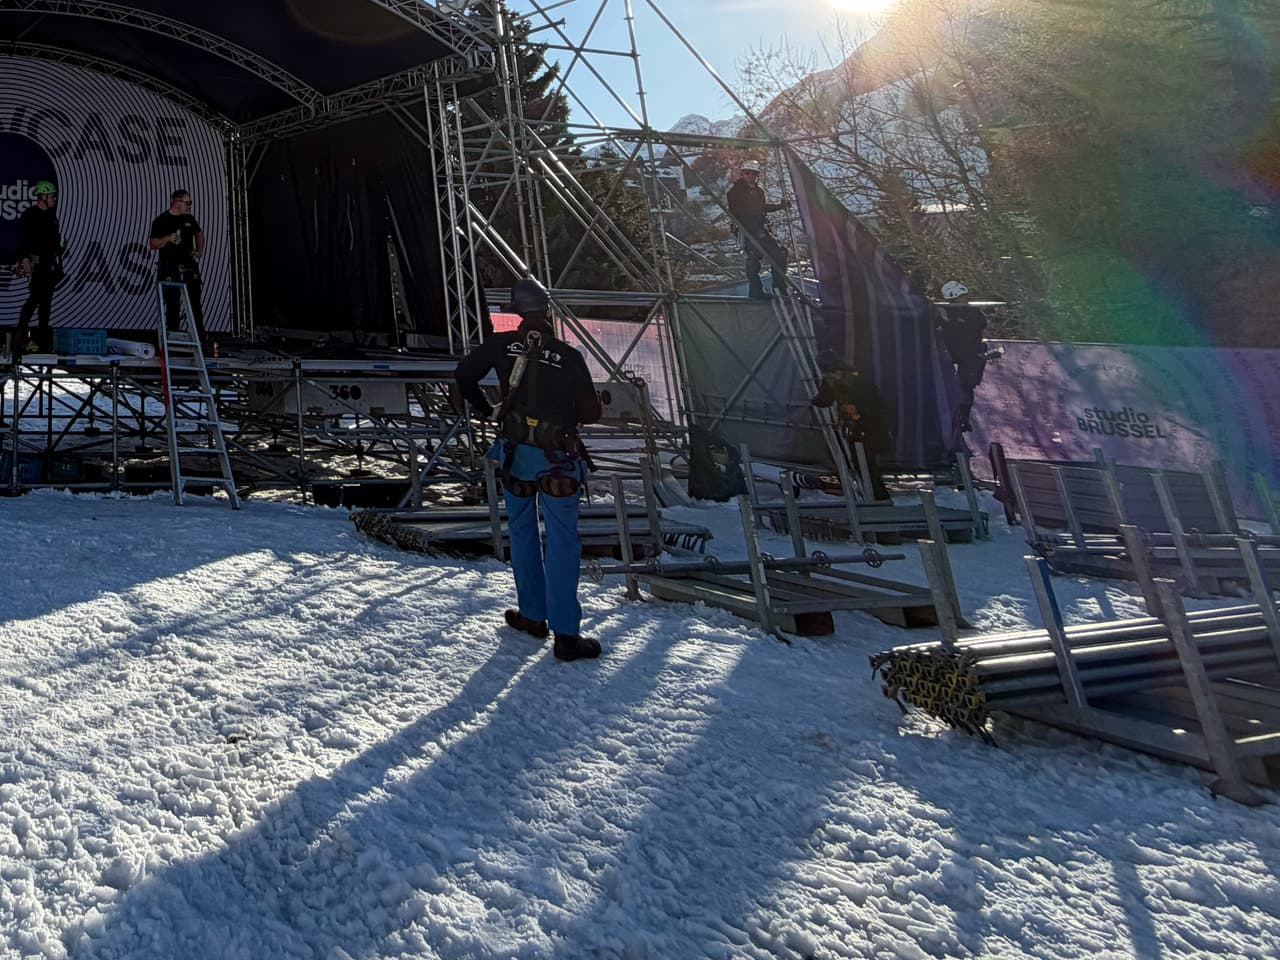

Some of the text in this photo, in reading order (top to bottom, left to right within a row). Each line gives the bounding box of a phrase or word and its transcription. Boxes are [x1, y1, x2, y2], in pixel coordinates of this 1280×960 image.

[329, 385, 362, 400] 360
[1084, 406, 1150, 424] studio
[1076, 417, 1168, 440] BRUSSEL
